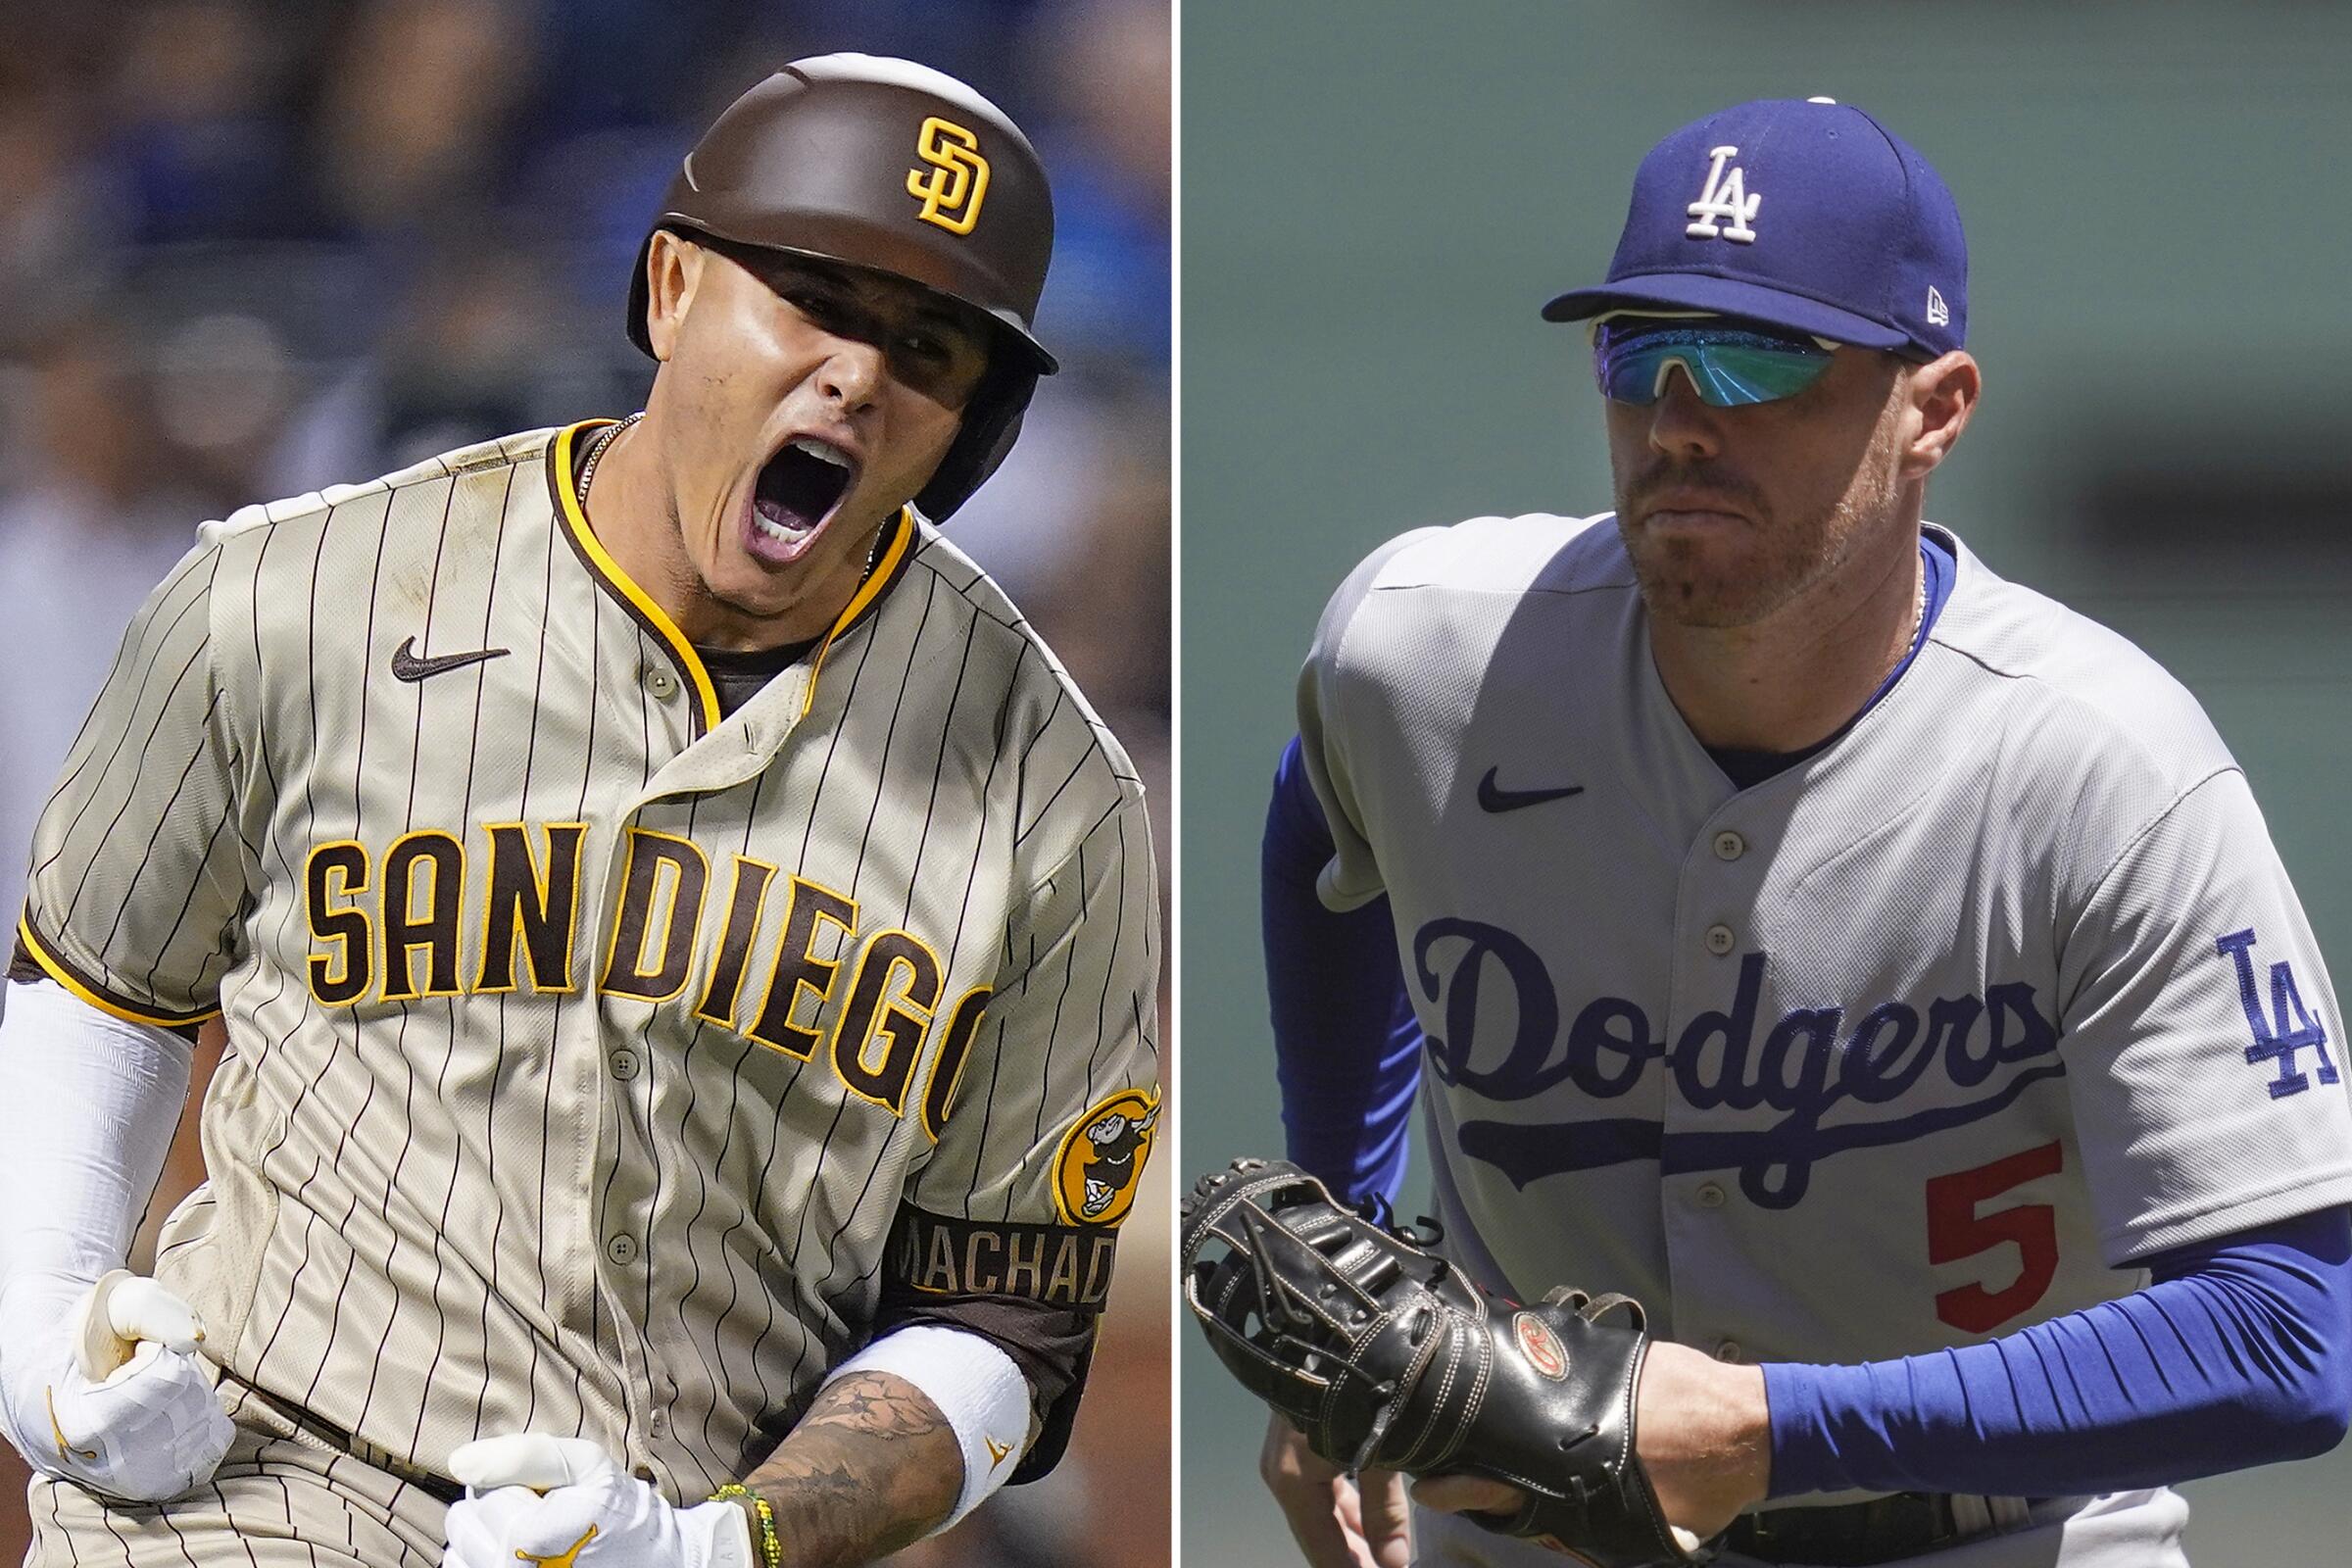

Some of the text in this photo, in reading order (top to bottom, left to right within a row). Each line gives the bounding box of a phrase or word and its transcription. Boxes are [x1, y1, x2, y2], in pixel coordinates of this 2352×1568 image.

[906, 116, 992, 236] SD
[1686, 145, 1761, 243] LA
[305, 821, 589, 1007] SAN
[1414, 917, 2064, 1209] Dodgers
[2216, 927, 2340, 1100] LA
[1926, 1139, 2063, 1334] 5
